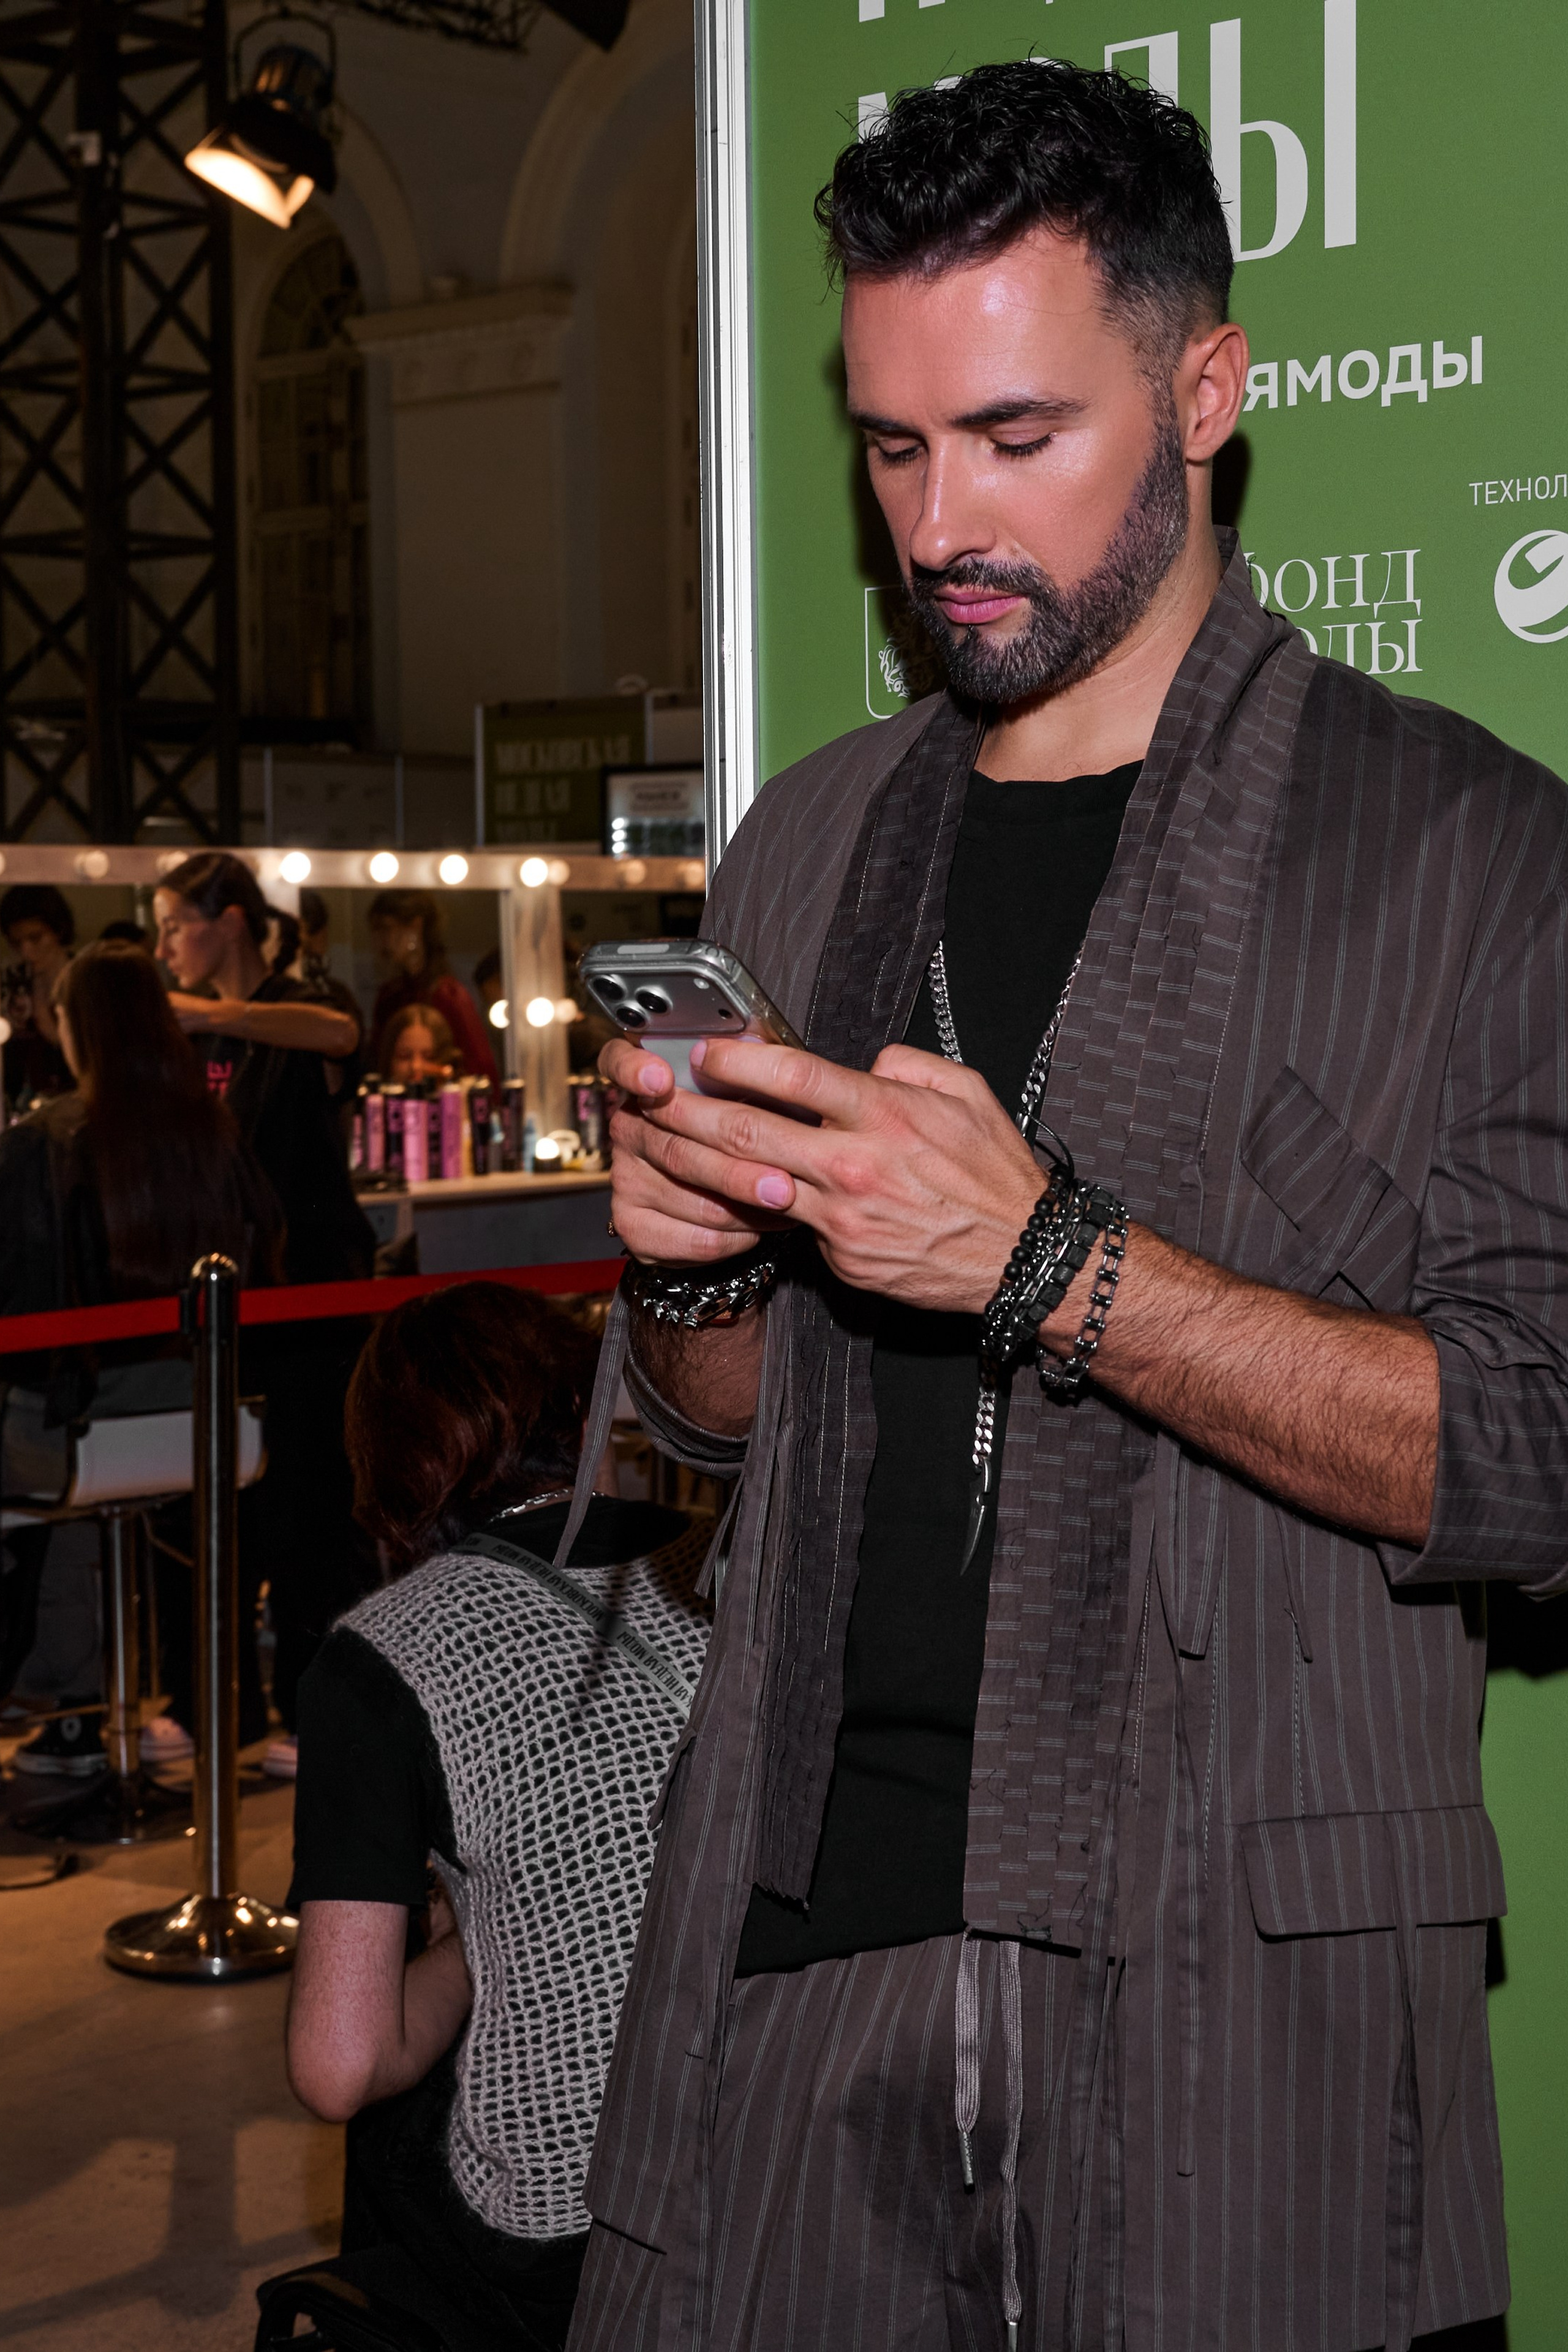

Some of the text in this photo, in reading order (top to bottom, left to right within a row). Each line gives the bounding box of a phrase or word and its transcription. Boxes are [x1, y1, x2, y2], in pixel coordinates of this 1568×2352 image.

[547, 1573, 604, 1621] МОСКОВСКАЯ
[617, 1631, 646, 1660] МОДЫ
[643, 1656, 679, 1690] НЕДЕЛЯ
